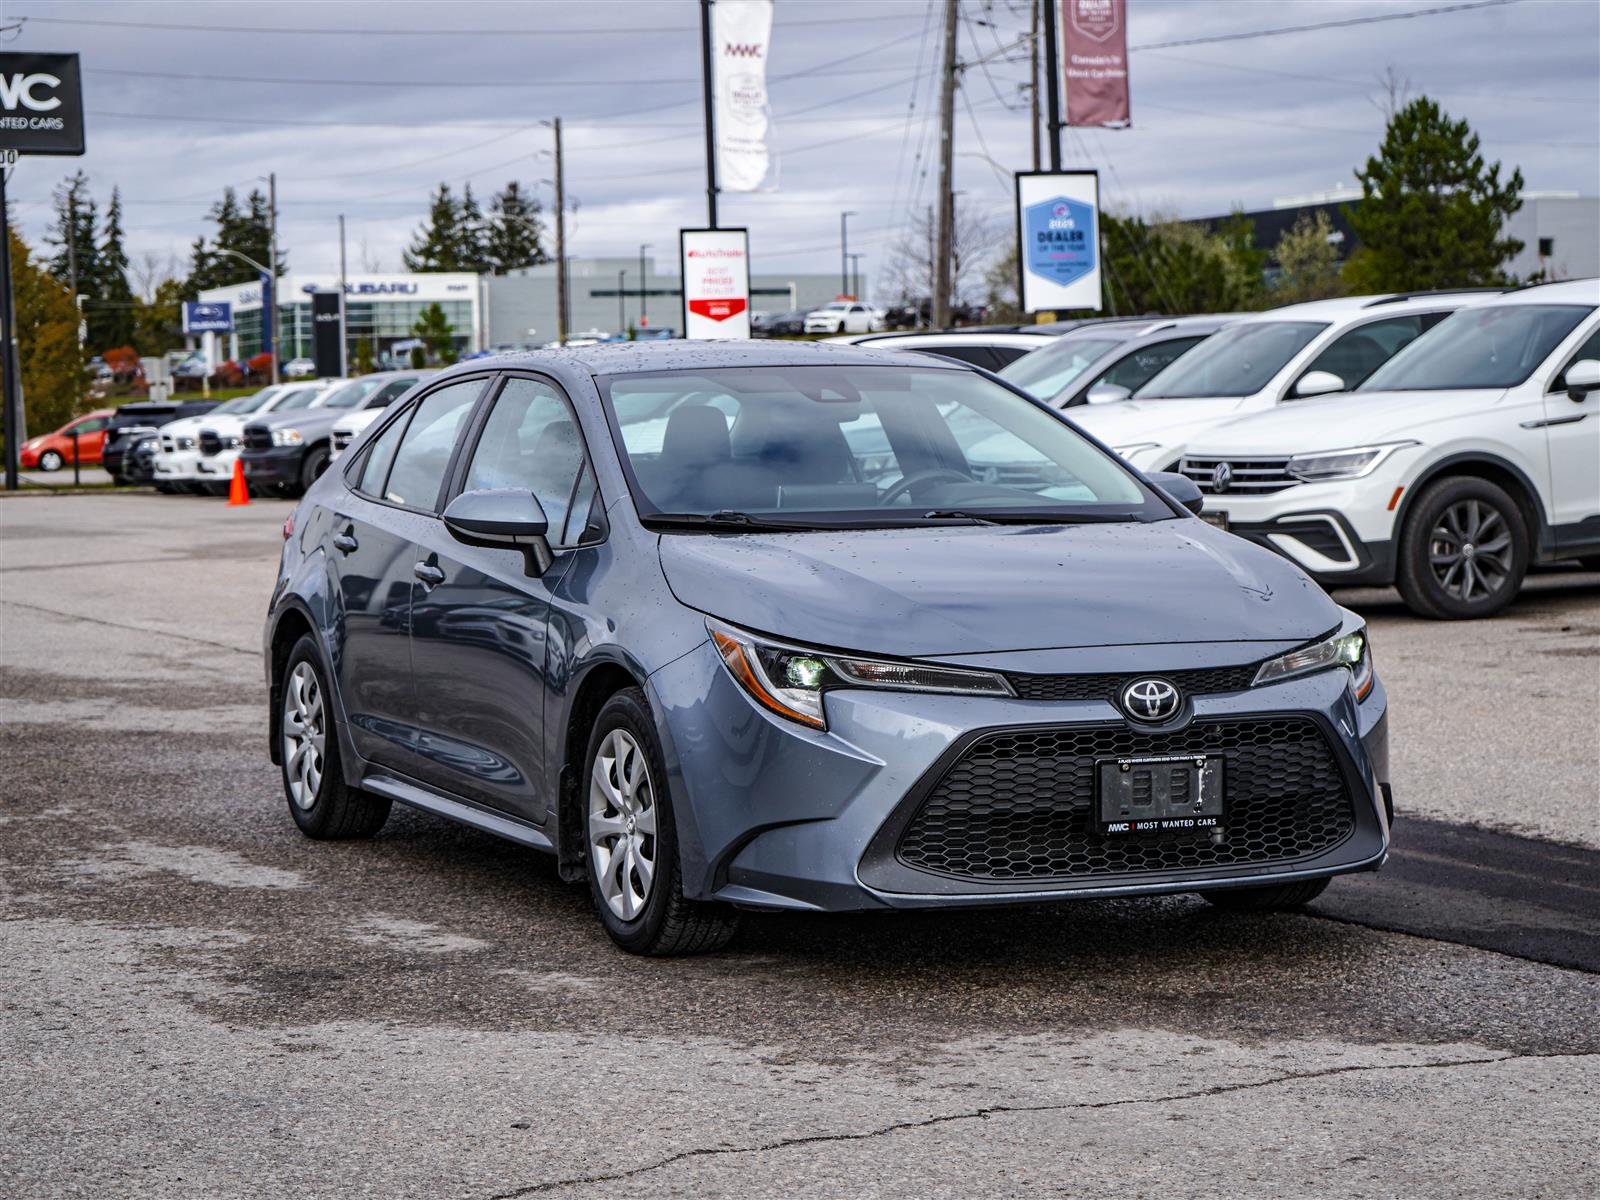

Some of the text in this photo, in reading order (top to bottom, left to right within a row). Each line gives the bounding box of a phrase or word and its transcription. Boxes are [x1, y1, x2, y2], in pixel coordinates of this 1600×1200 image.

[29, 117, 64, 130] CARS
[1037, 231, 1085, 242] DEALER
[1038, 244, 1048, 252] OF
[1051, 244, 1065, 252] THE
[342, 283, 417, 295] SUBARU
[1136, 821, 1159, 830] MOST
[1161, 819, 1195, 829] WANTED
[1197, 818, 1217, 827] CARS
